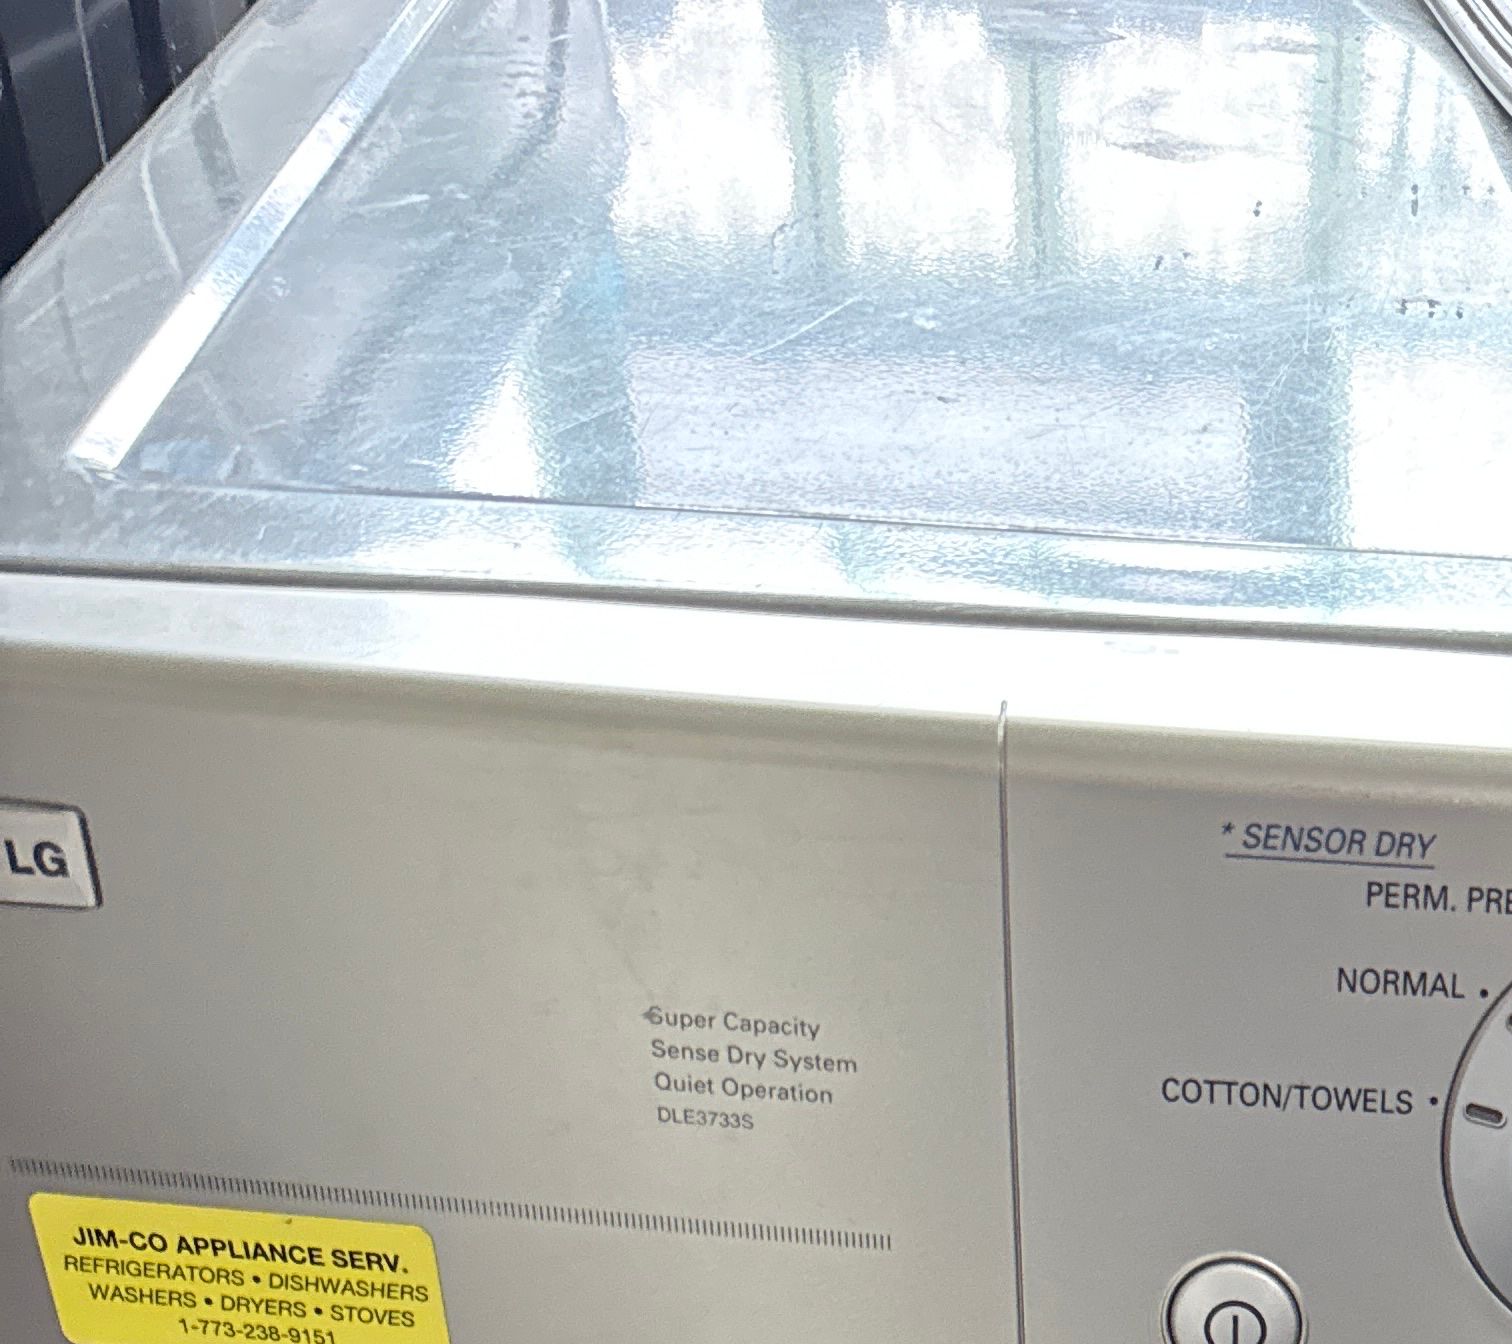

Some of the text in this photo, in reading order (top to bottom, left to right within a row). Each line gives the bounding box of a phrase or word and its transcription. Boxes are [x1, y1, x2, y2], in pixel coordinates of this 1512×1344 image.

[5, 839, 70, 878] LG
[1242, 823, 1438, 859] SENSOR DRY
[1366, 882, 1456, 912] PERM.
[1337, 968, 1465, 1000] NORMAL
[649, 1005, 820, 1041] Super Capacity
[651, 1039, 858, 1072] Sense Dry System
[655, 1072, 833, 1104] Quiet Operation
[1161, 1077, 1413, 1114] COTTON/TOWELS
[657, 1106, 754, 1129] DLE3733S
[72, 1226, 408, 1273] JIM-CO APPLIANCE SERV.
[63, 1255, 429, 1302] REFRIGERATORS DISHWASHERS
[88, 1283, 415, 1328] WASHERS DRYERS STOVES
